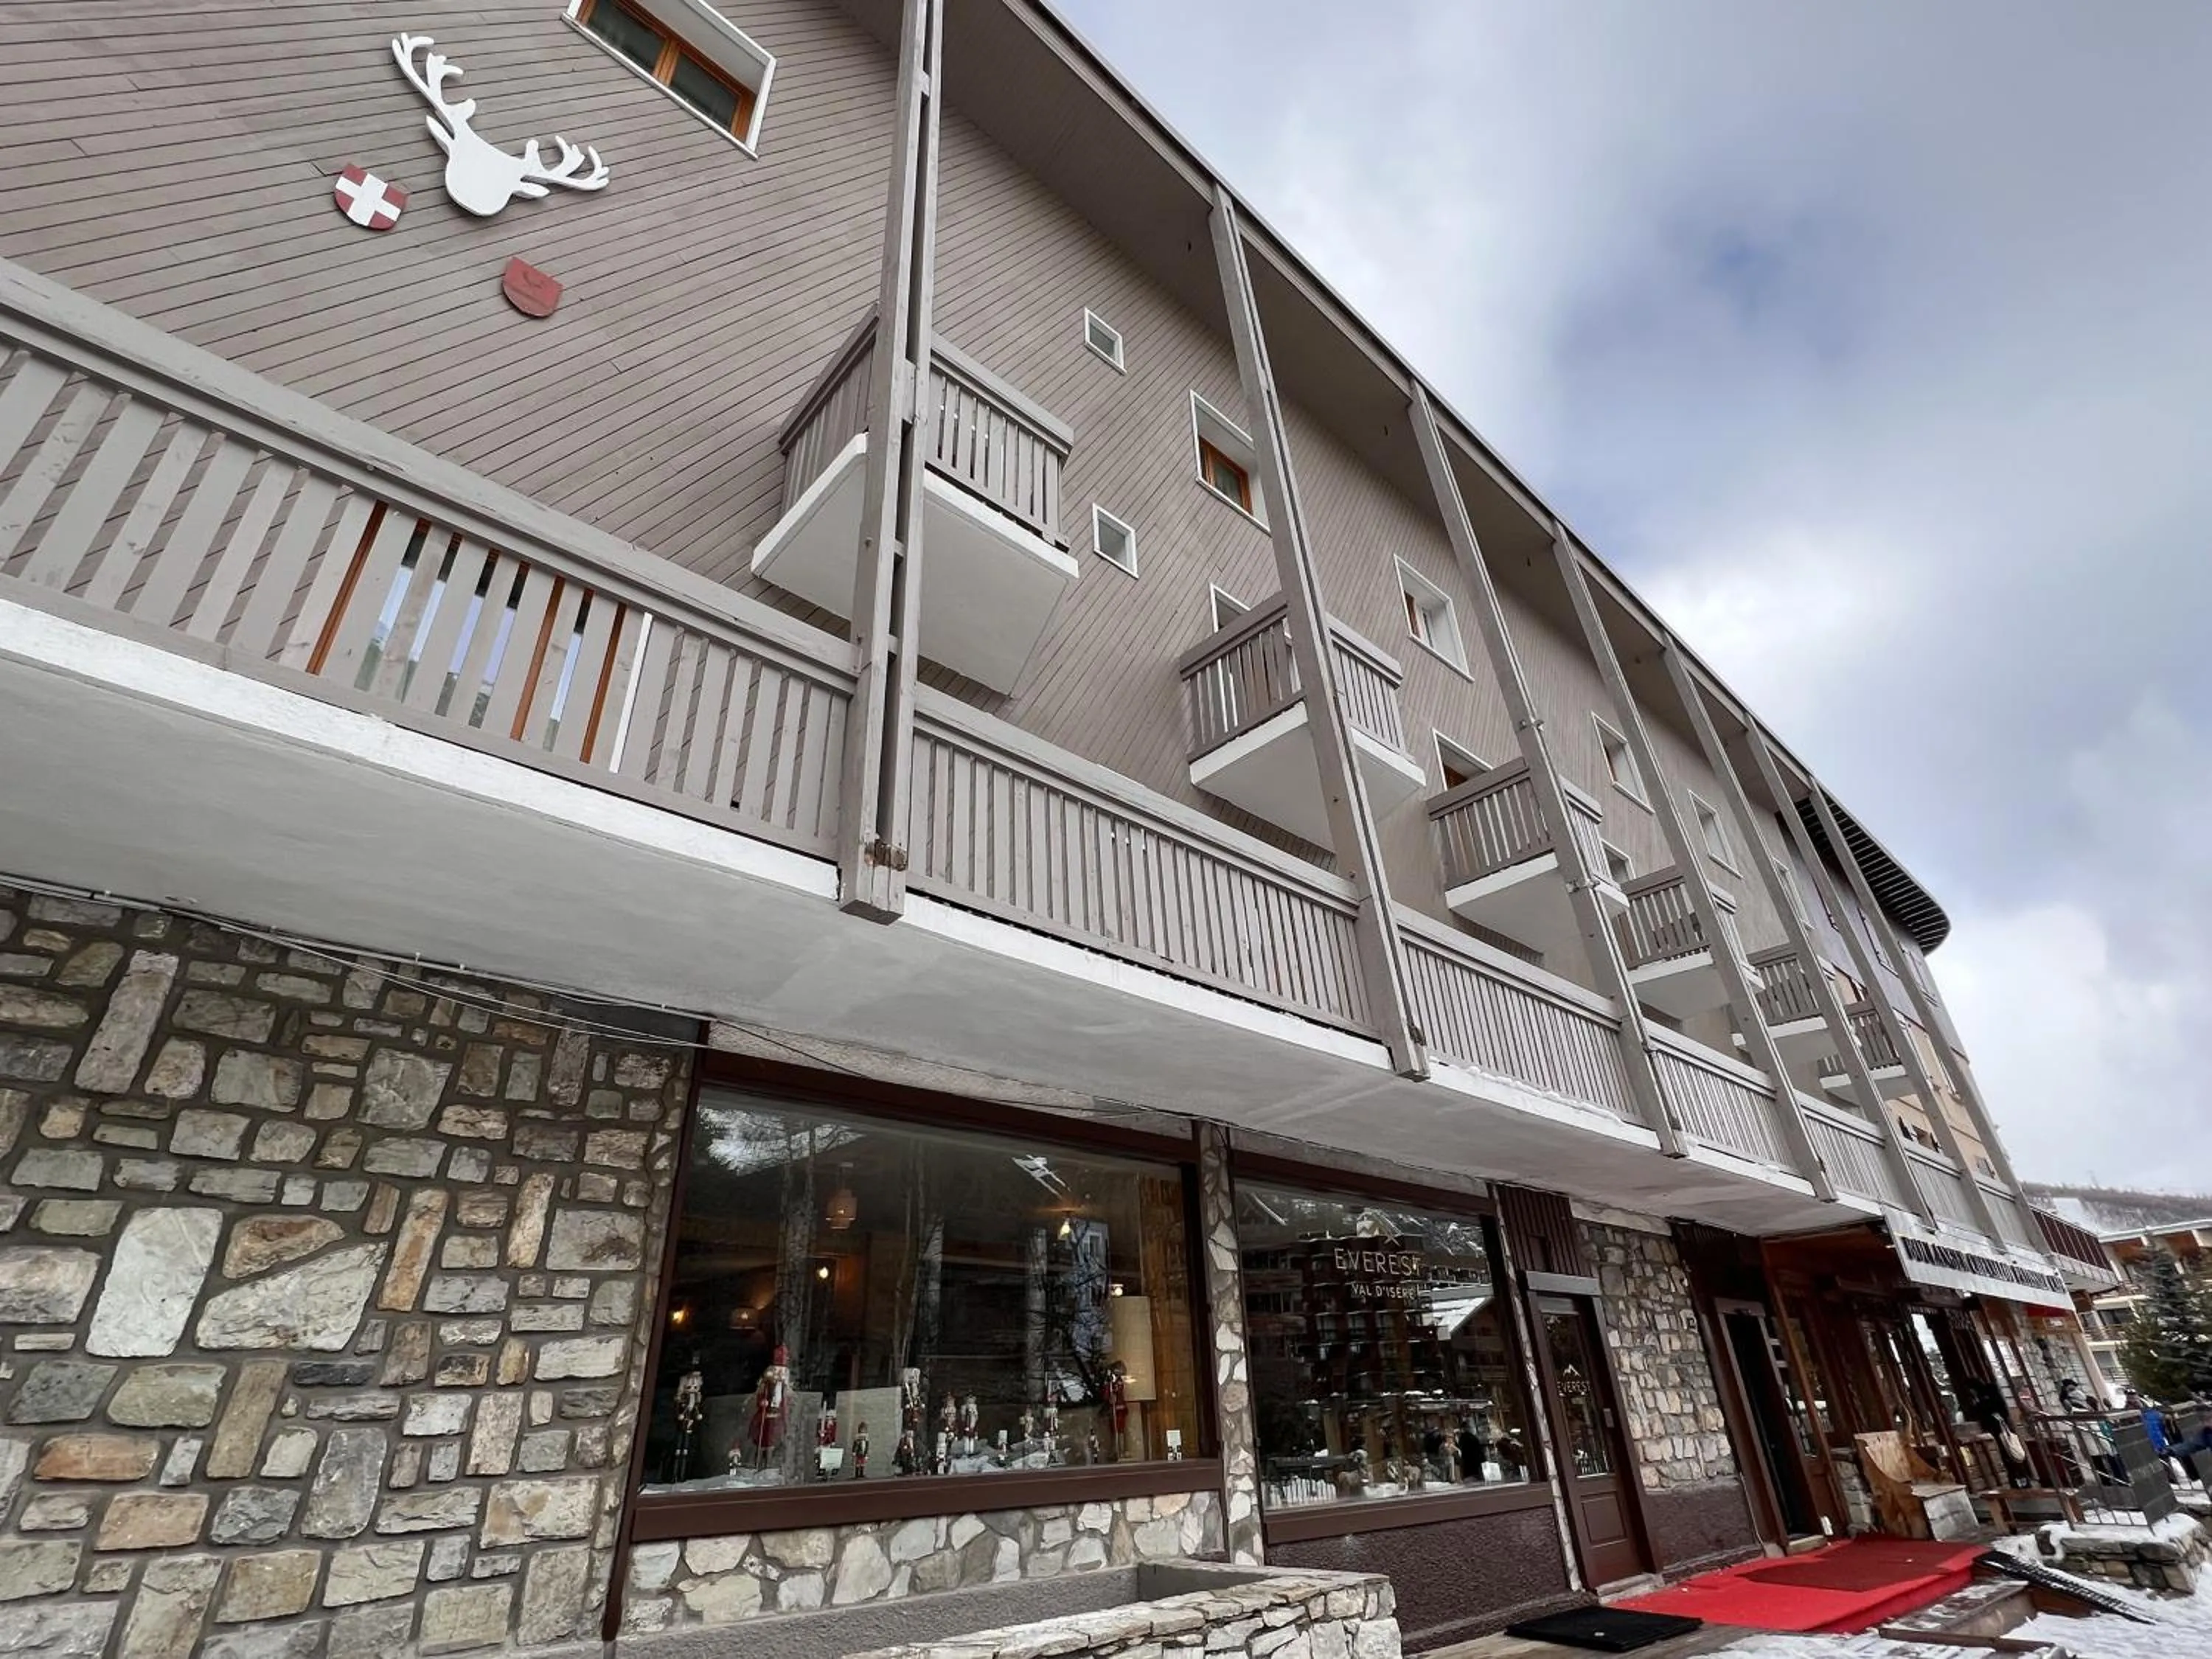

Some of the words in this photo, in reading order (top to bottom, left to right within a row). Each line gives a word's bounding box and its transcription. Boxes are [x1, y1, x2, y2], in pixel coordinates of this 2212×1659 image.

[1334, 1248, 1422, 1277] EVEREST
[1352, 1283, 1372, 1296] VAL
[1557, 1380, 1590, 1393] EVEREST
